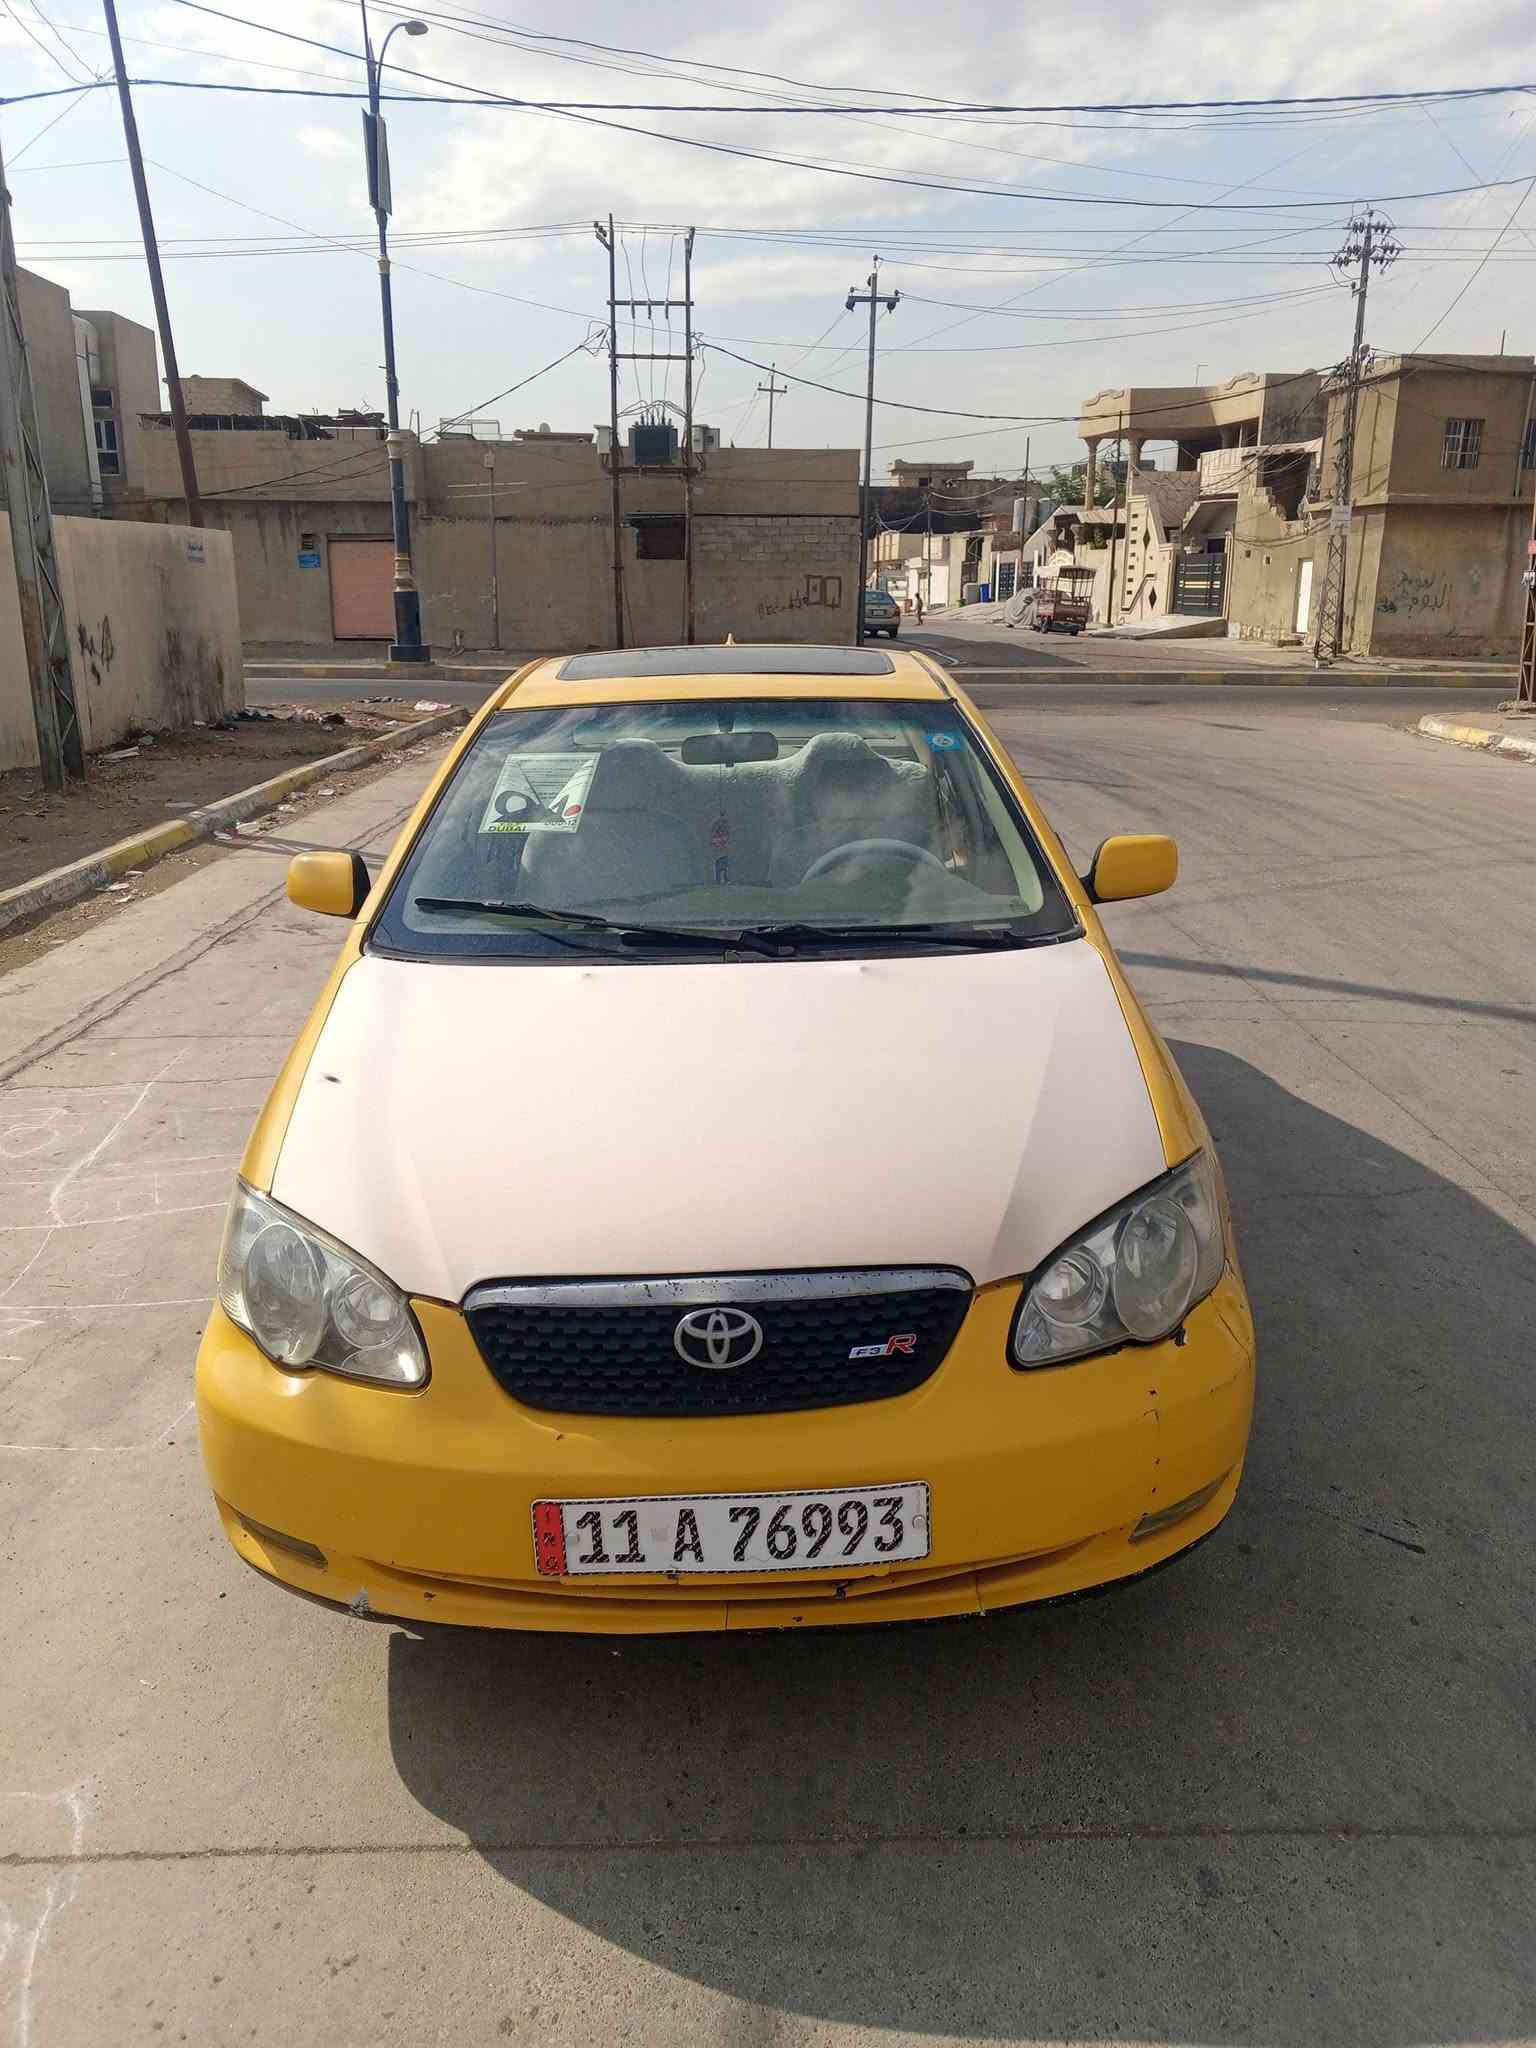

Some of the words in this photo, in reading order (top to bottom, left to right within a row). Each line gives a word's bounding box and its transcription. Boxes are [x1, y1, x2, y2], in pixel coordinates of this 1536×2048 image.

[576, 1509, 646, 1564] 11
[673, 1508, 704, 1563] A
[728, 1495, 905, 1563] 76993
